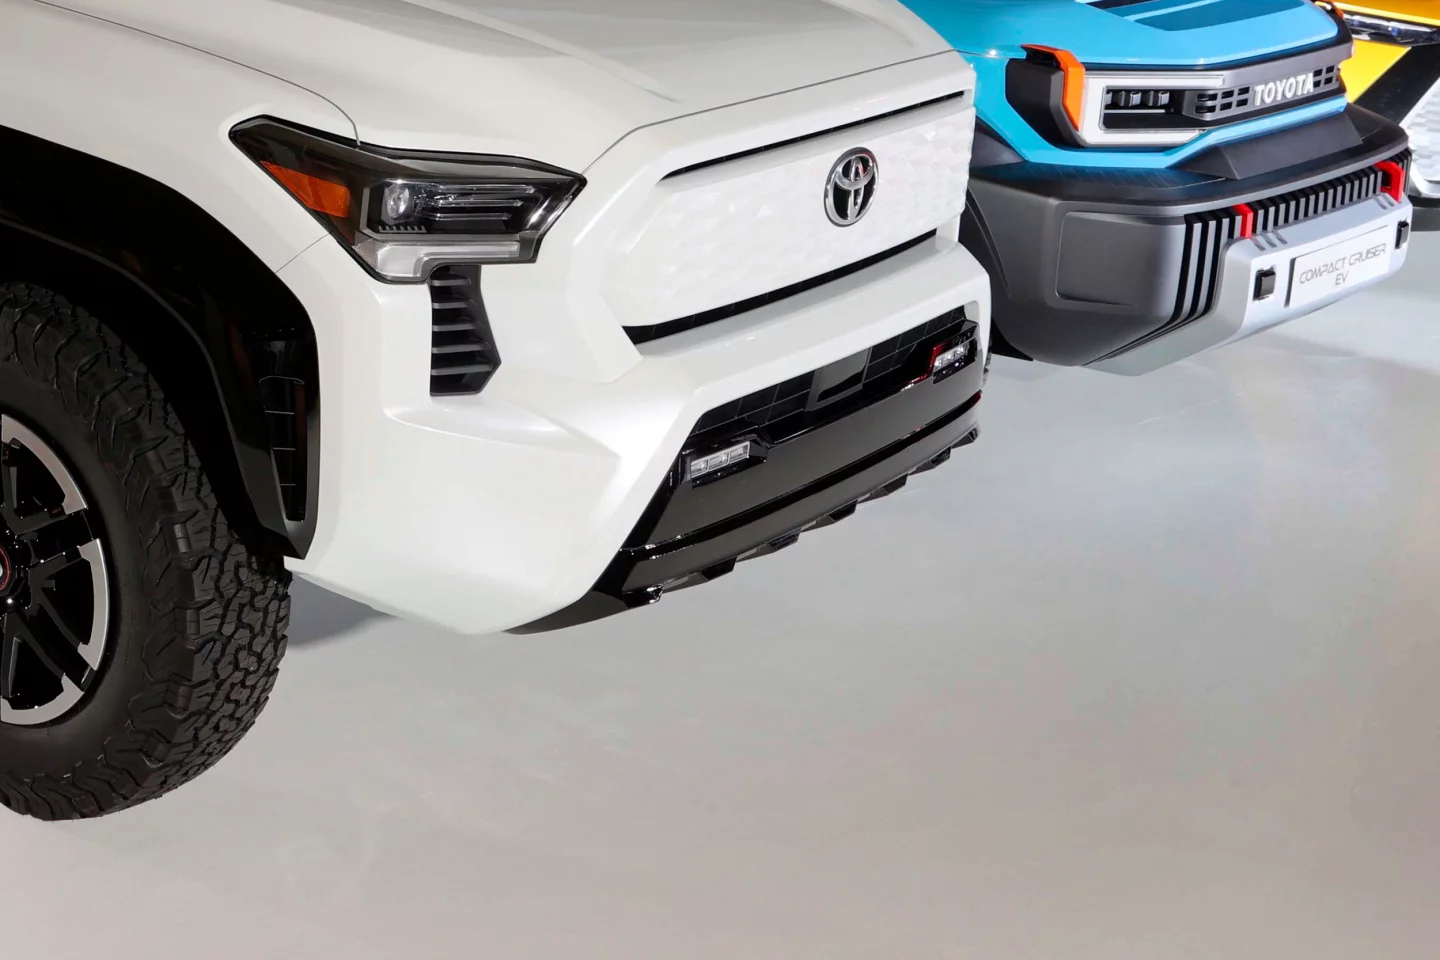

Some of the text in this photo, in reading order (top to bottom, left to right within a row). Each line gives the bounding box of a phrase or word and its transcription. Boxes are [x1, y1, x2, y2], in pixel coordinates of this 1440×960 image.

[1254, 72, 1314, 106] TOYOTA
[1299, 243, 1387, 284] COMPACT CRUISER
[1335, 271, 1350, 286] EV
